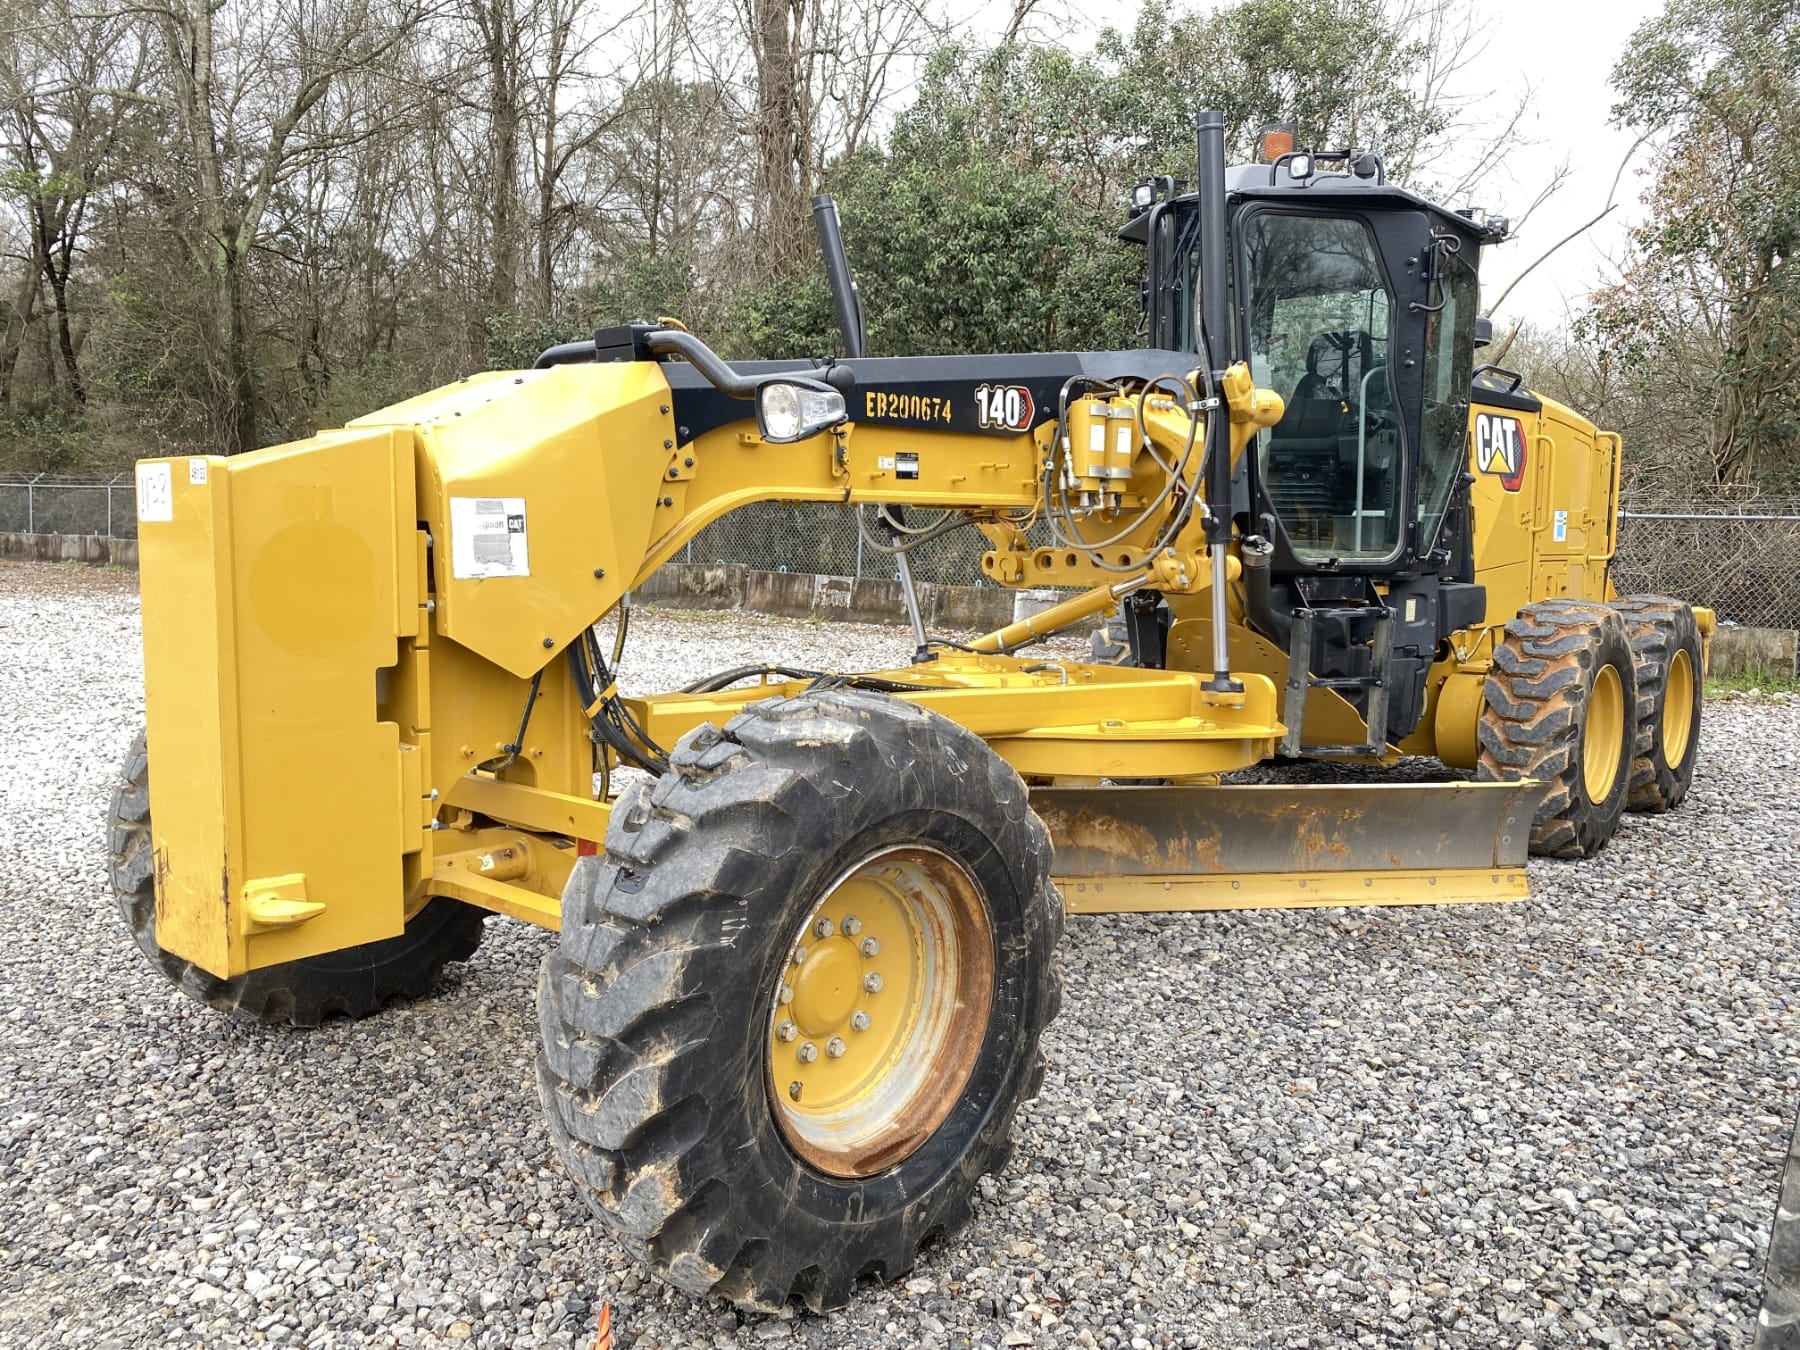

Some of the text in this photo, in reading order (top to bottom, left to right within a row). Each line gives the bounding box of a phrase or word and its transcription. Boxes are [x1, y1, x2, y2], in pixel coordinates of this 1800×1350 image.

[977, 385, 1020, 427] 140
[1477, 414, 1516, 473] CAT
[508, 519, 524, 529] CAT
